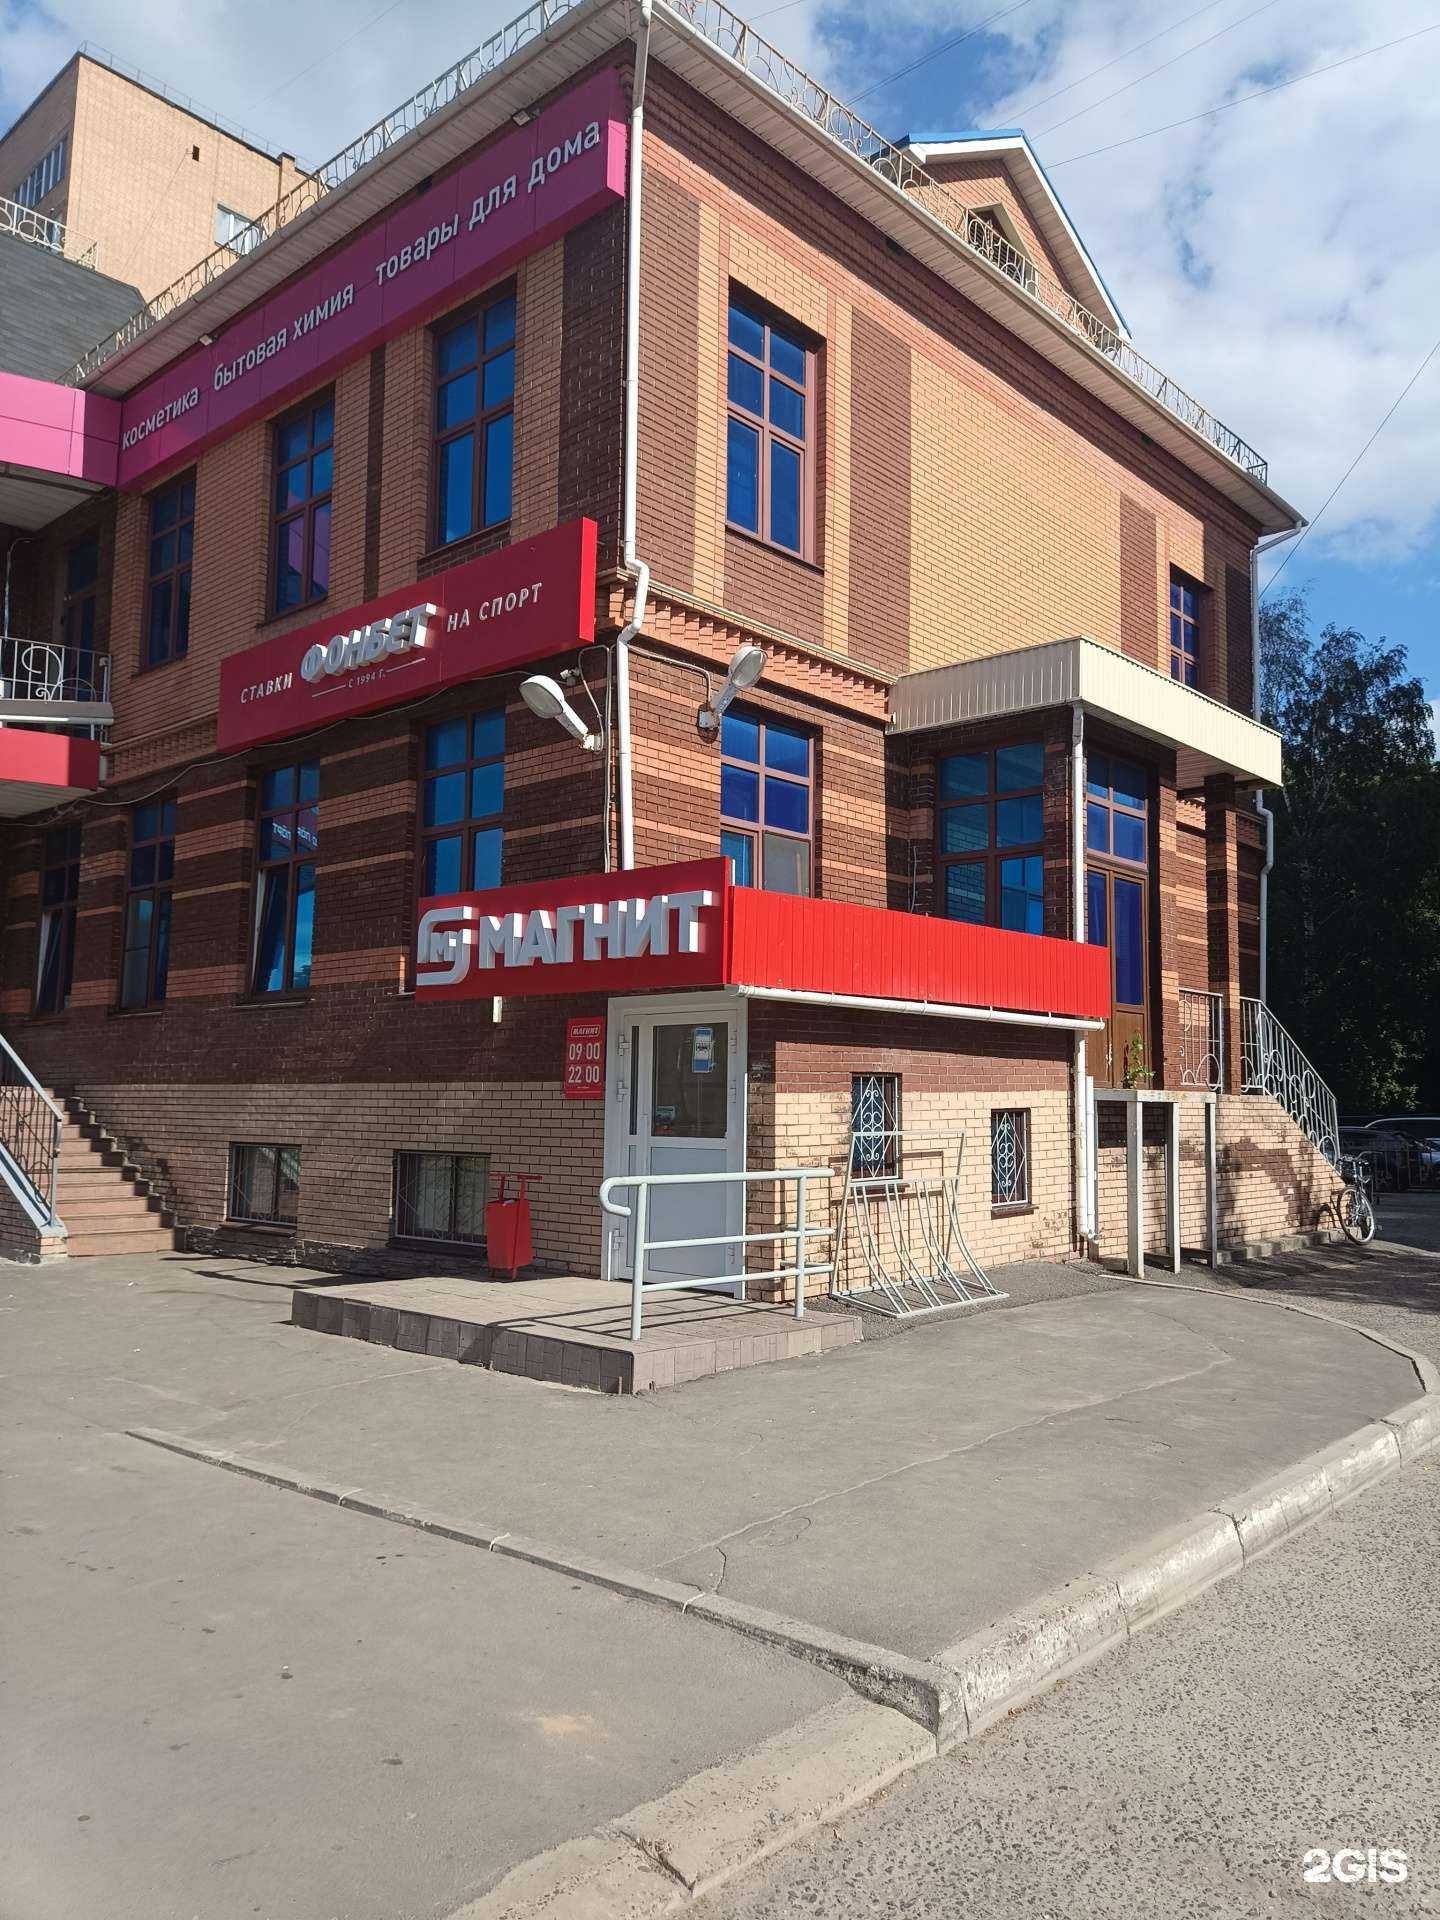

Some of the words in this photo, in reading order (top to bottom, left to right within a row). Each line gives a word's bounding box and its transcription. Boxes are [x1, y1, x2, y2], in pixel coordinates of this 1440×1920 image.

[121, 386, 200, 451] косметика
[213, 327, 287, 392] бытовая
[292, 283, 354, 341] химия
[375, 213, 459, 286] товары
[468, 174, 517, 232] для
[527, 121, 601, 193] дома
[240, 671, 293, 704] СТАВКИ
[300, 602, 437, 683] ФОНБЕТ
[446, 608, 470, 633] НА
[479, 581, 543, 620] СПОРТ
[356, 671, 376, 687] 1994
[478, 889, 713, 969] МАГНИТ
[572, 1026, 599, 1035] МАГНИТ
